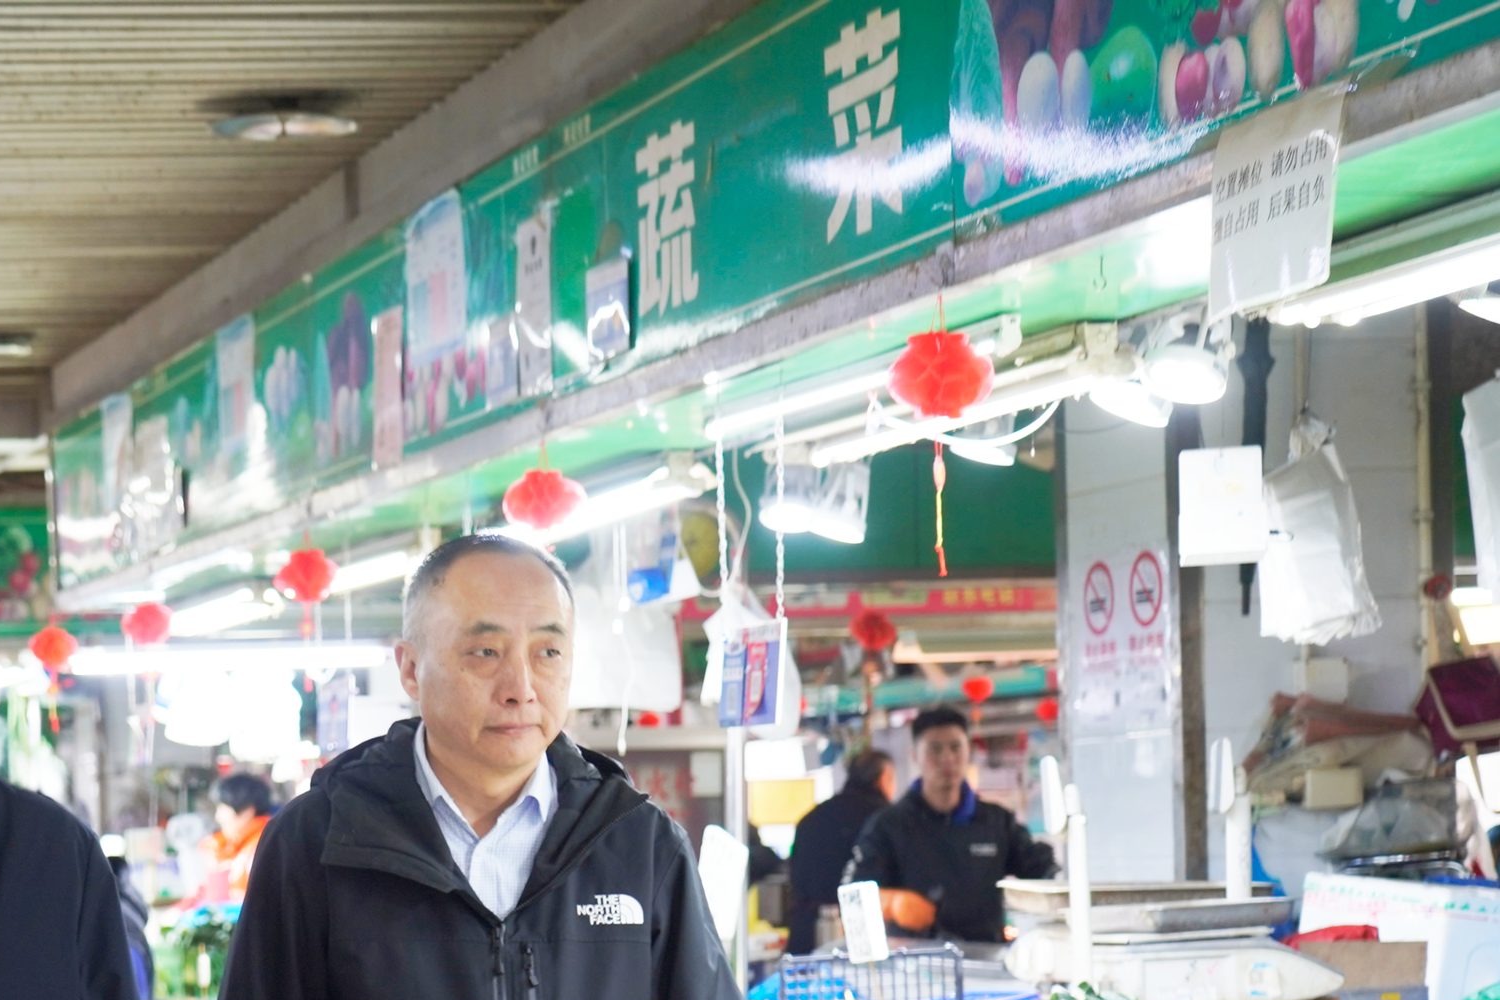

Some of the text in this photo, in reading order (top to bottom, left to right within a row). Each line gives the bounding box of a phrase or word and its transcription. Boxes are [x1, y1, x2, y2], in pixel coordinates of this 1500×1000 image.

[1215, 132, 1329, 203] 空置摊位 请勿占用
[1267, 174, 1325, 221] 后果自负
[594, 894, 620, 905] THE
[576, 904, 620, 915] NORTH
[590, 914, 621, 925] FACE
